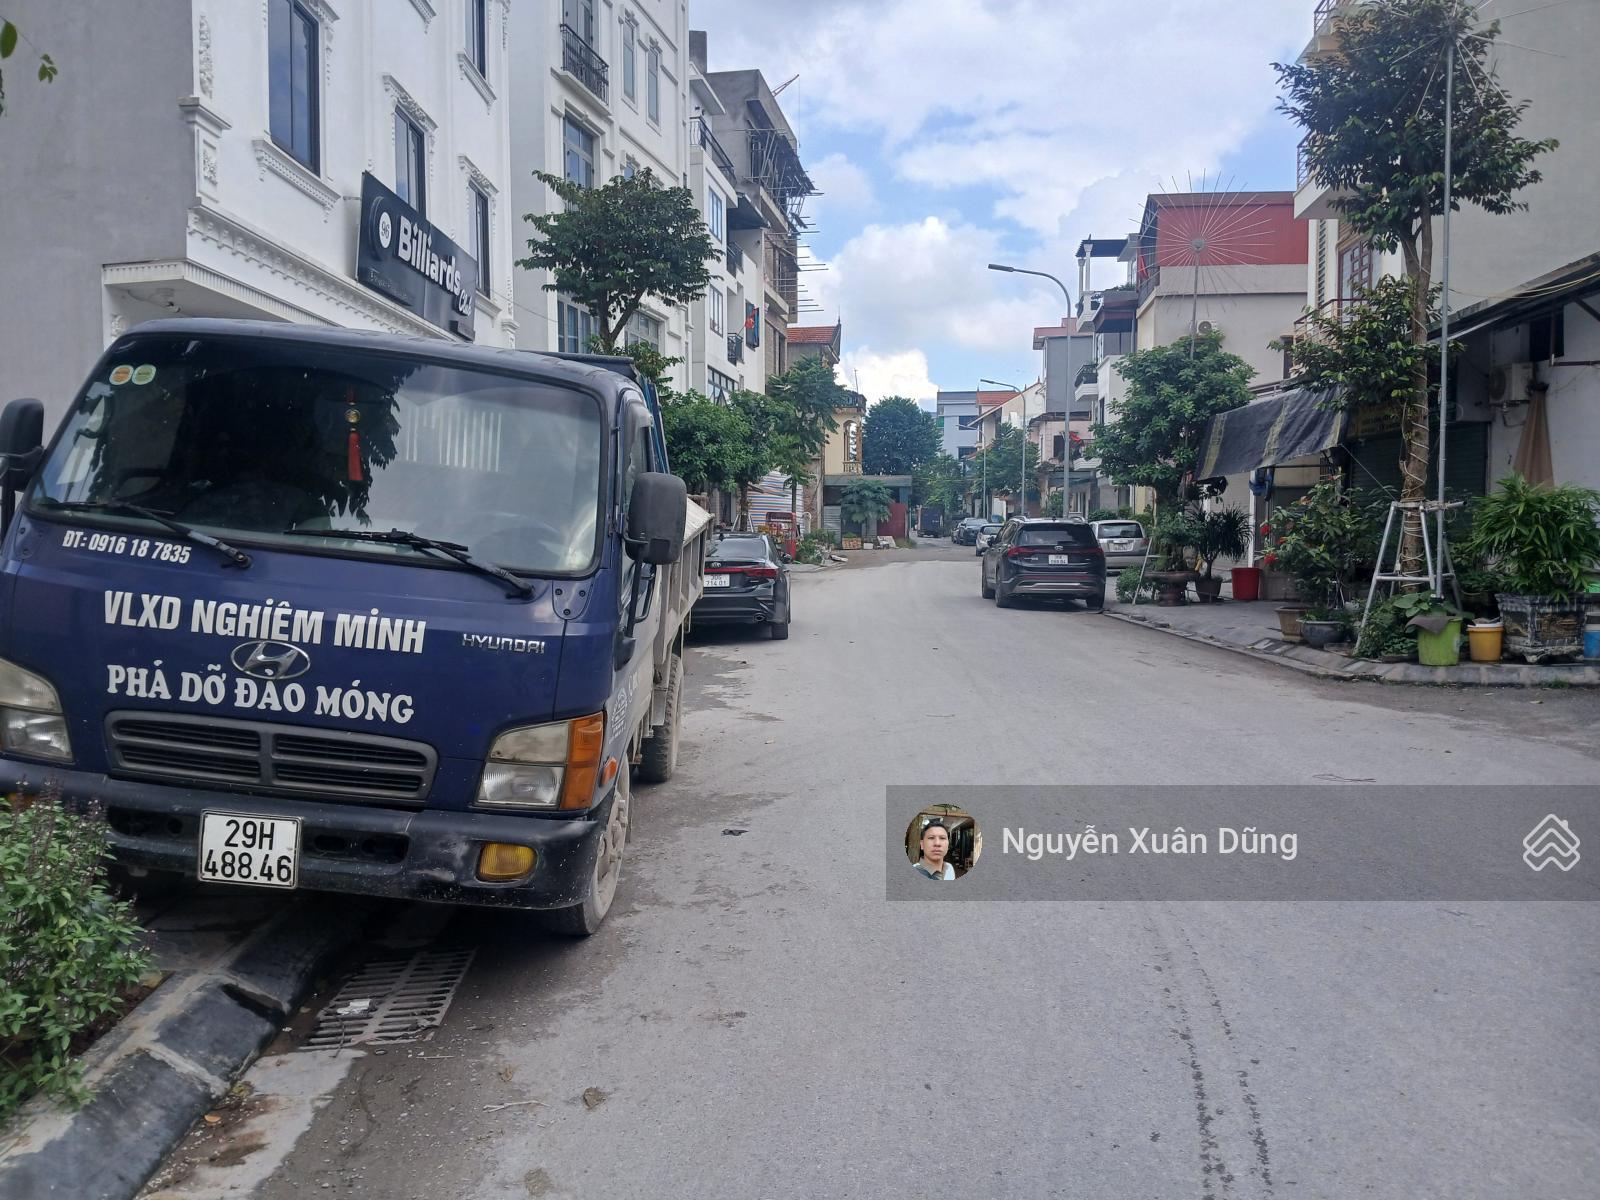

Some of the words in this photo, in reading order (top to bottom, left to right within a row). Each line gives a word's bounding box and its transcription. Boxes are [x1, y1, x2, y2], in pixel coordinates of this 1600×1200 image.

[398, 215, 461, 296] Billiards
[62, 530, 88, 548] ĐT:
[88, 533, 127, 554] 0916
[130, 538, 150, 557] 18
[151, 541, 192, 564] 7835
[104, 590, 182, 630] VLXD
[462, 633, 546, 655] HYUNDAI
[234, 668, 306, 713] ĐÀO
[314, 679, 415, 724] MÓNG
[224, 819, 275, 850] 29H
[203, 849, 292, 882] 488.46
